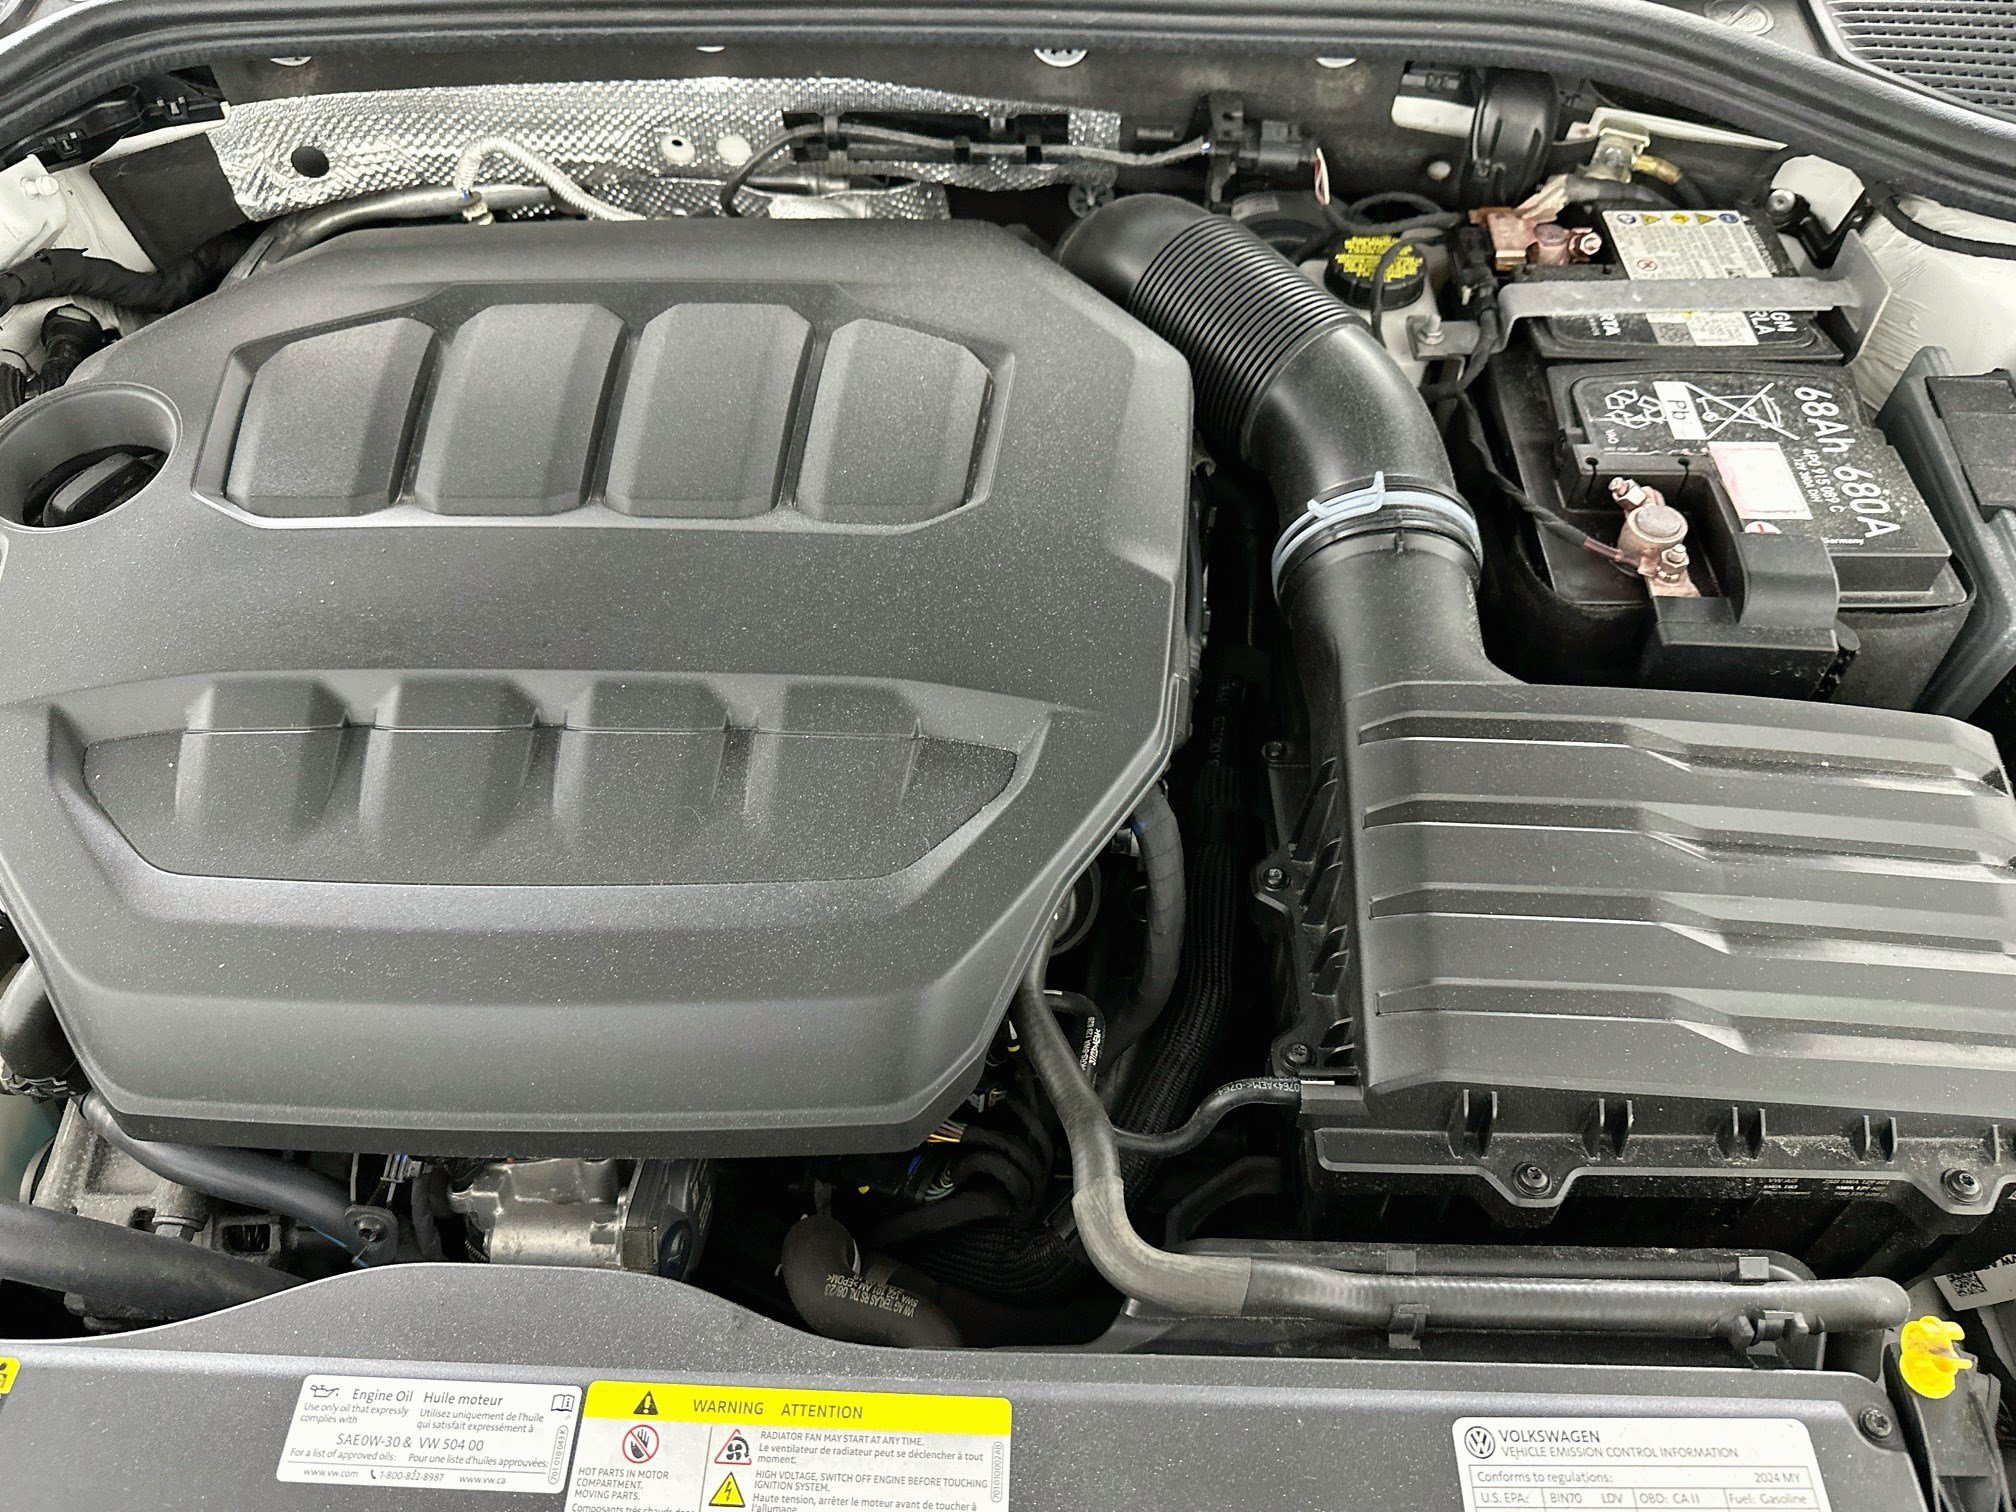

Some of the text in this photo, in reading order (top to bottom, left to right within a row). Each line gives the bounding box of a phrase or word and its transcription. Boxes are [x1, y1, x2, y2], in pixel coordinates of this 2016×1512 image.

[1600, 312, 1621, 336] RTA
[1750, 312, 1776, 335] RLA
[1770, 312, 1797, 332] GM
[1667, 400, 1690, 420] Pb
[1794, 387, 1856, 452] 68Ah
[1833, 466, 1900, 538] 680A
[352, 1389, 413, 1403] Engine Oil
[424, 1392, 503, 1406] Huile moteur
[304, 1402, 409, 1418] Use only oil that expressly
[420, 1408, 544, 1422] Utilisez uniquement de l'huile
[693, 1400, 863, 1420] WARNING ATTENTION
[300, 1414, 358, 1424] complies with
[416, 1420, 534, 1433] qui satisfait expressément à
[760, 1430, 924, 1446] RADIATOR FAN MAY START AT ANY TIME.
[1499, 1430, 1600, 1442] VOLKSWAGEN
[402, 1436, 412, 1448] &
[419, 1437, 440, 1449] VW
[442, 1438, 465, 1450] 504
[468, 1440, 484, 1451] 00
[290, 1448, 304, 1456] For
[312, 1448, 325, 1457] list
[327, 1449, 338, 1458] of
[338, 1450, 378, 1460] approved
[379, 1452, 396, 1460] oils:
[759, 1444, 769, 1452] Le
[771, 1444, 818, 1454] ventilateur
[820, 1446, 830, 1454] de
[833, 1447, 872, 1456] radiateur
[874, 1450, 894, 1459] peut
[908, 1450, 955, 1460] déclencher
[958, 1451, 963, 1460] à
[965, 1453, 984, 1461] tout
[1502, 1446, 1740, 1458] VEHICLE EMISSION CONTROL INFORMATION
[408, 1453, 428, 1462] Pour
[447, 1455, 464, 1464] liste
[466, 1456, 496, 1466] d'huiles
[498, 1458, 548, 1468] approuvées:
[758, 1456, 796, 1464] moment.
[304, 1468, 358, 1478] www.vw.com
[380, 1470, 444, 1482] 1-800-822-8987
[578, 1467, 669, 1480] HOT PARTS IN MOTOR
[756, 1470, 988, 1488] HIGH VOLTAGE, SWITCH OFF ENGINE BEFORE TOUCHING
[1478, 1471, 1530, 1482] Conforms
[1533, 1473, 1544, 1482] to
[1754, 1472, 1800, 1484] 2024 MY
[460, 1475, 506, 1485] www.vw.ca
[576, 1478, 644, 1490] COMPARTMENT.
[754, 1480, 830, 1492] IGNITION SYSTEM.
[574, 1490, 640, 1500] MOVING PARTS.
[1480, 1492, 1502, 1504] U.S.
[1550, 1492, 1582, 1504] BIN70
[1601, 1493, 1624, 1504] LDV
[1639, 1493, 1668, 1504] OBD:
[1760, 1494, 1807, 1504] Gasoline
[752, 1492, 779, 1503] Haute
[782, 1495, 816, 1506] tension,
[818, 1496, 848, 1506] arrêter
[850, 1497, 859, 1506] le
[861, 1500, 892, 1508] moteur
[922, 1500, 934, 1510] de
[936, 1501, 969, 1511] toucher
[971, 1503, 976, 1512] à
